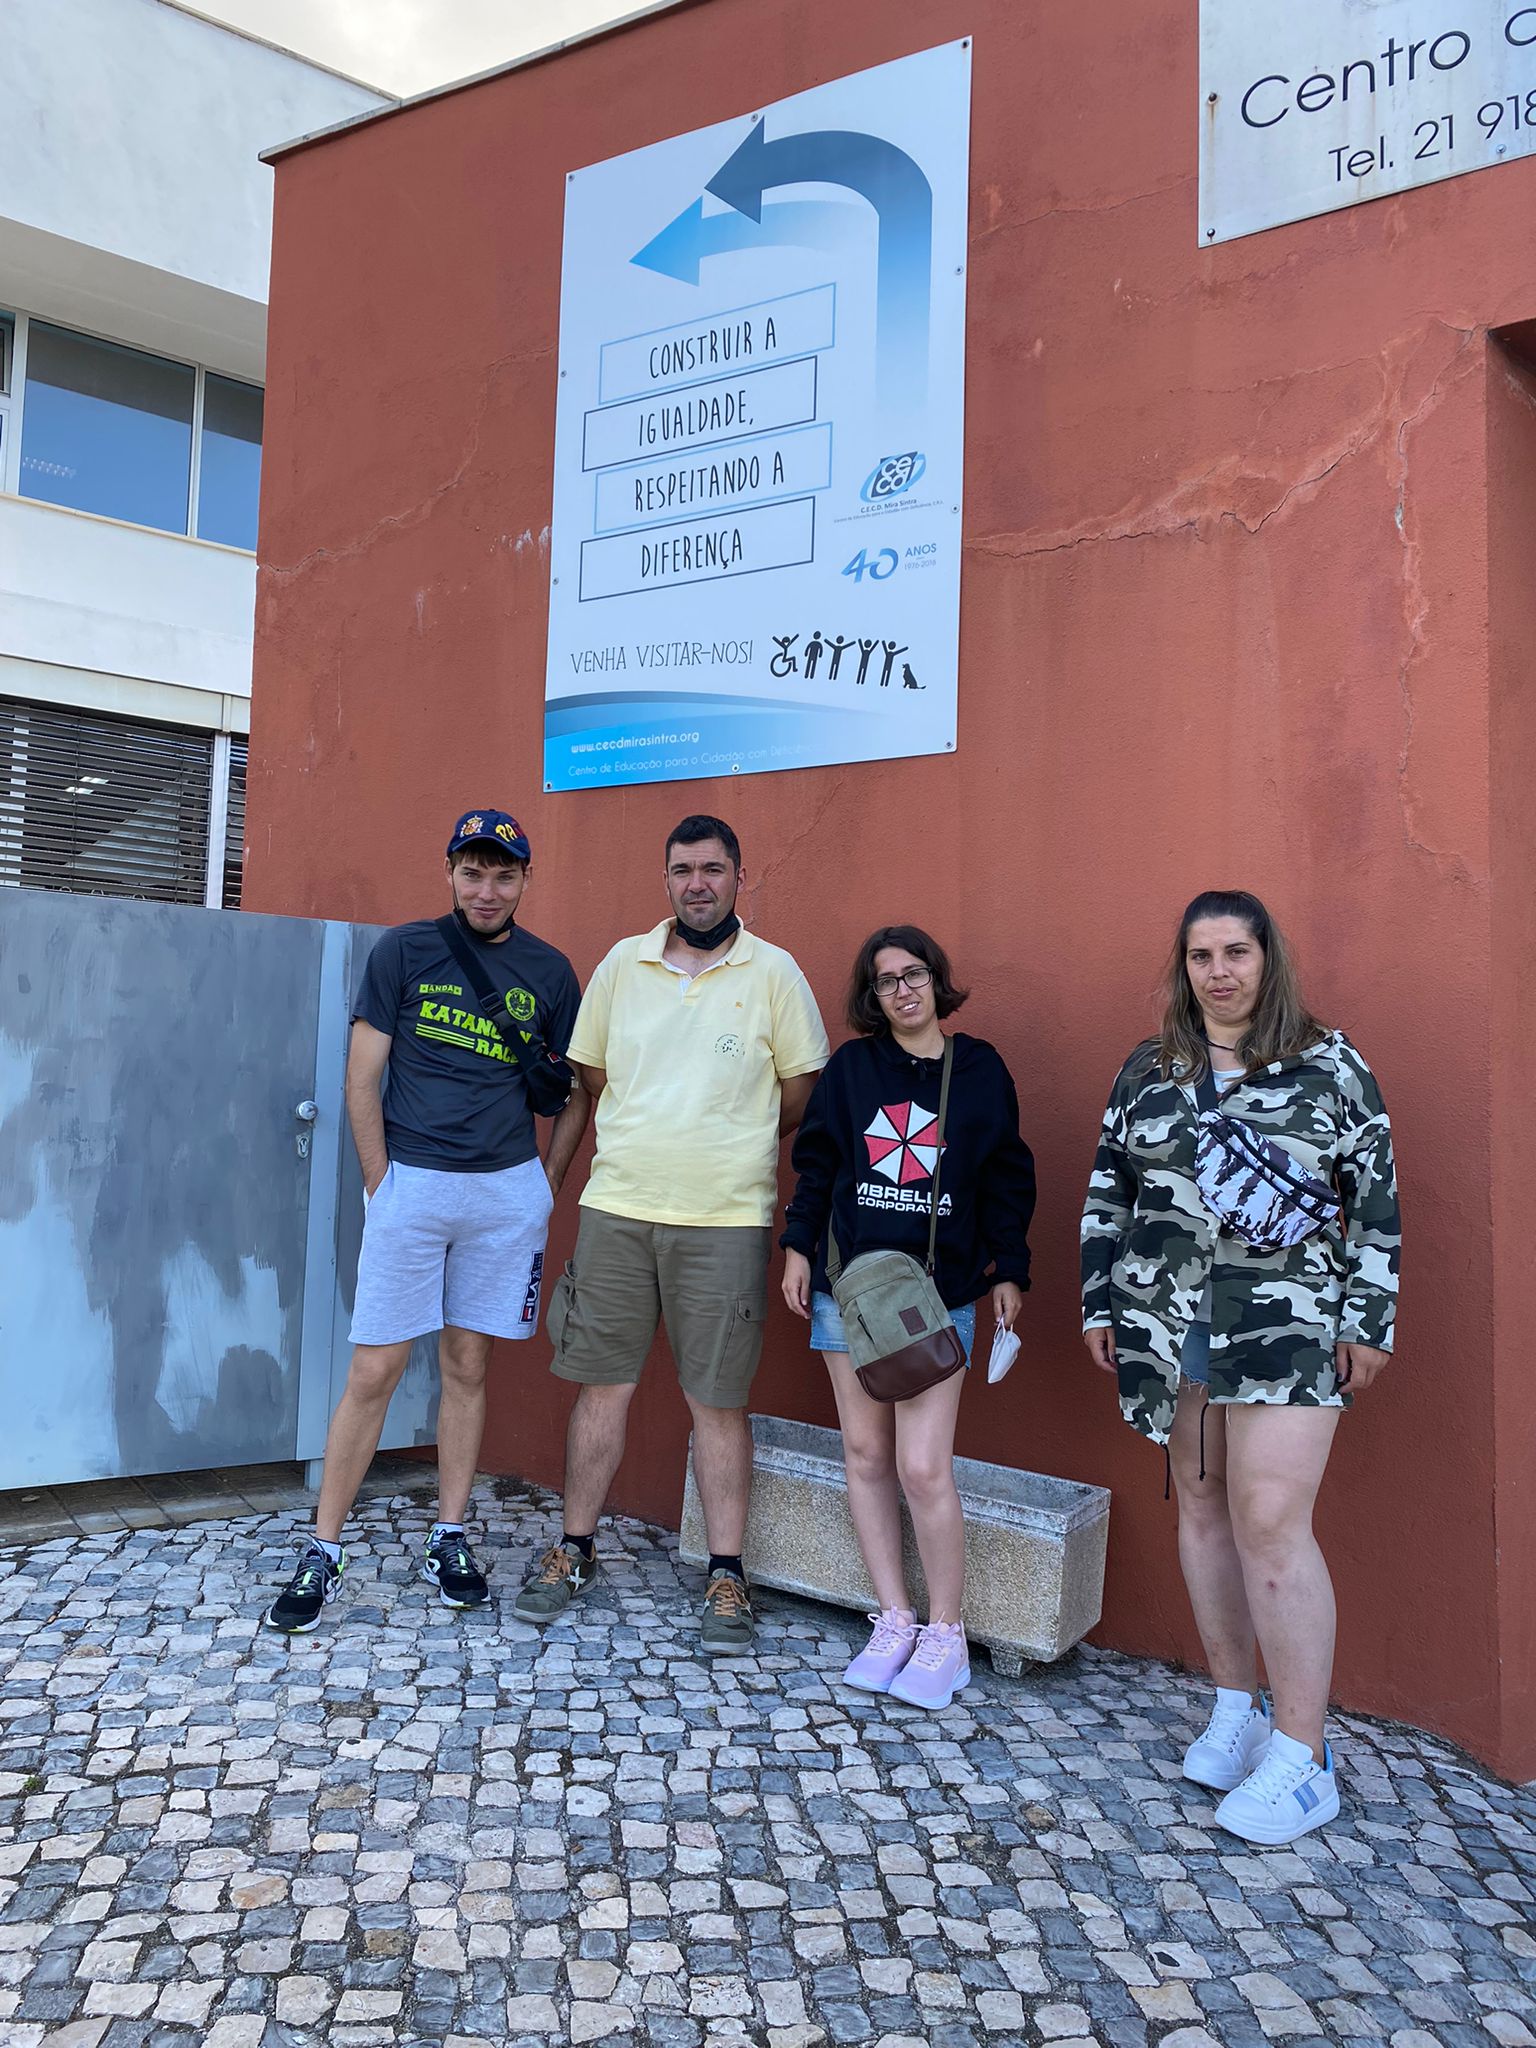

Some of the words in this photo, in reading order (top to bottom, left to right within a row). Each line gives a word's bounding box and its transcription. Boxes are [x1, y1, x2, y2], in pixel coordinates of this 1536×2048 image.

[1240, 30, 1472, 128] Centro
[1328, 136, 1394, 182] Tel.
[1413, 114, 1455, 160] 21
[649, 320, 753, 379] CONSTRUIR
[765, 317, 777, 350] A
[638, 390, 754, 447] IGUALDADE,
[635, 455, 761, 512] RESPEITANDO
[773, 451, 785, 485] A
[884, 501, 899, 510] Mira
[899, 498, 918, 507] Sintra
[641, 528, 743, 578] DIFERENÇA
[841, 547, 899, 583] 40
[905, 543, 937, 558] ANOS
[570, 646, 627, 674] VENHA
[636, 640, 754, 668] VISITAR-NOS!
[571, 731, 699, 753] www.cecdmirasintra.org
[568, 764, 598, 777] Centro
[600, 762, 612, 773] de
[614, 760, 662, 772] Educação
[665, 757, 689, 769] para
[691, 756, 698, 765] o
[700, 750, 745, 764] Cidadão
[857, 1197, 952, 1216] CORPORATON
